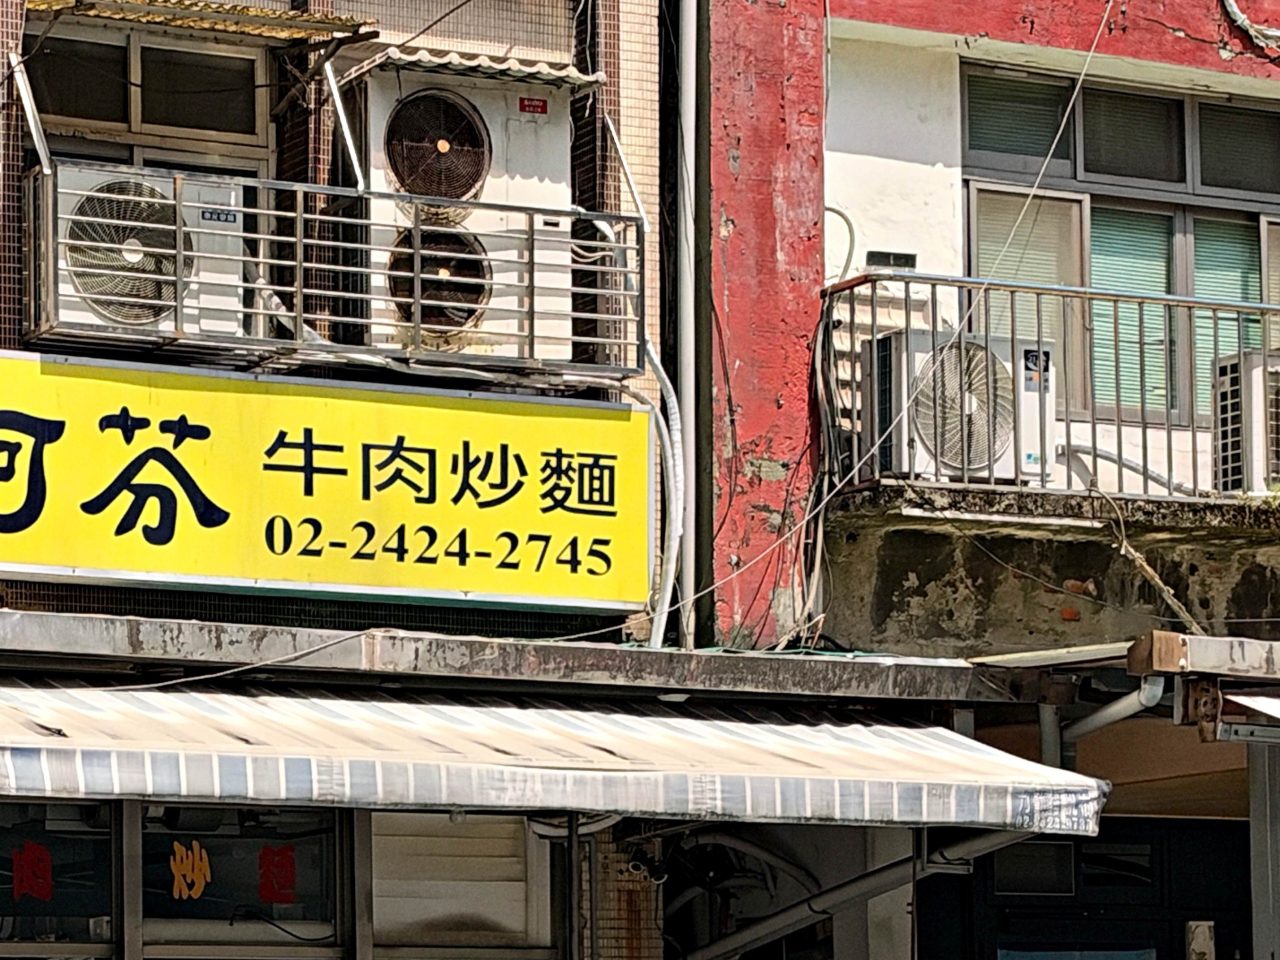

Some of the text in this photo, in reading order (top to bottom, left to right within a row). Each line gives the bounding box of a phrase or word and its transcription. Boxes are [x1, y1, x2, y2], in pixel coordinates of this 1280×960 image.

[262, 427, 619, 519] 牛肉炒麵
[264, 511, 615, 578] 02-2424-2745
